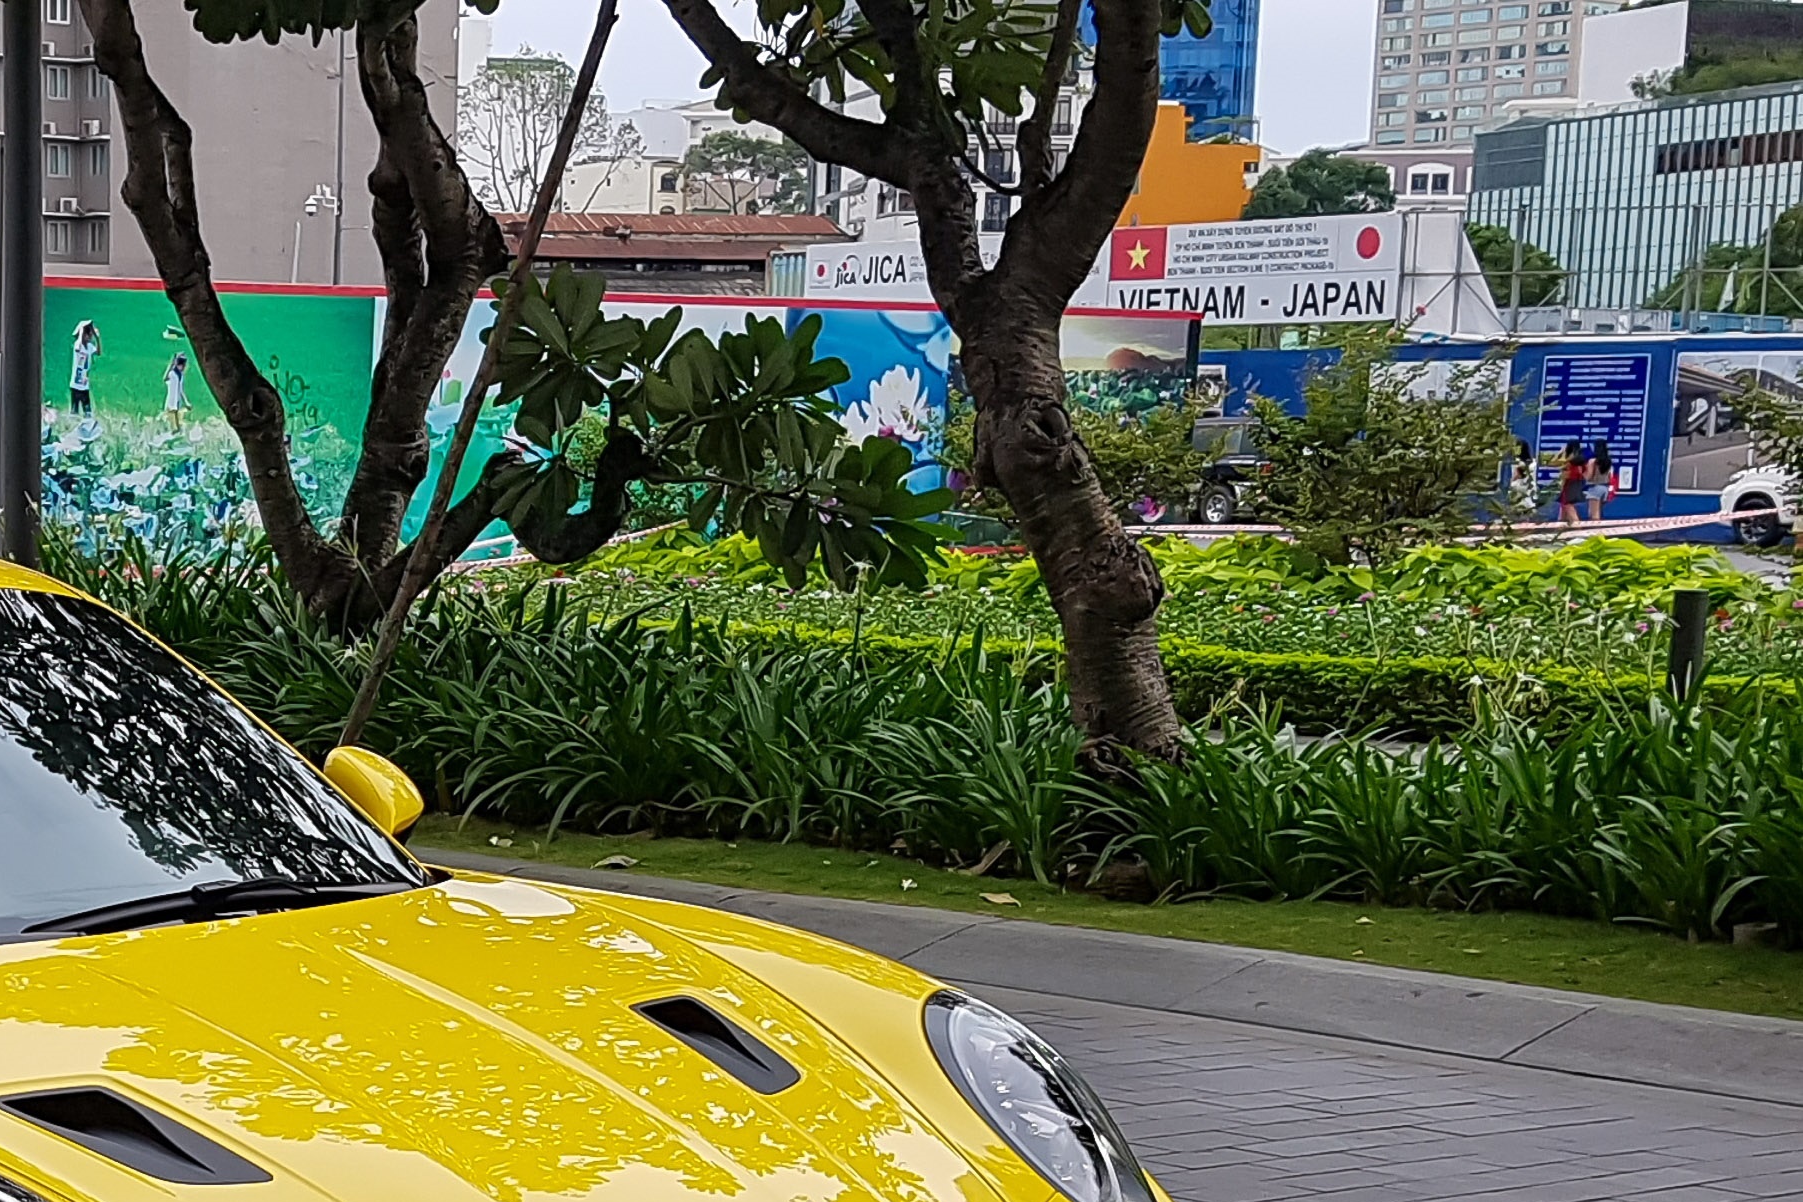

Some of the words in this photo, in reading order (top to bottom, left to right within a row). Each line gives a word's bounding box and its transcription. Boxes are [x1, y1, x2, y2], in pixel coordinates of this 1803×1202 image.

[863, 254, 907, 284] JICA
[1119, 286, 1245, 319] VIETNAM
[1282, 280, 1386, 318] JAPAN
